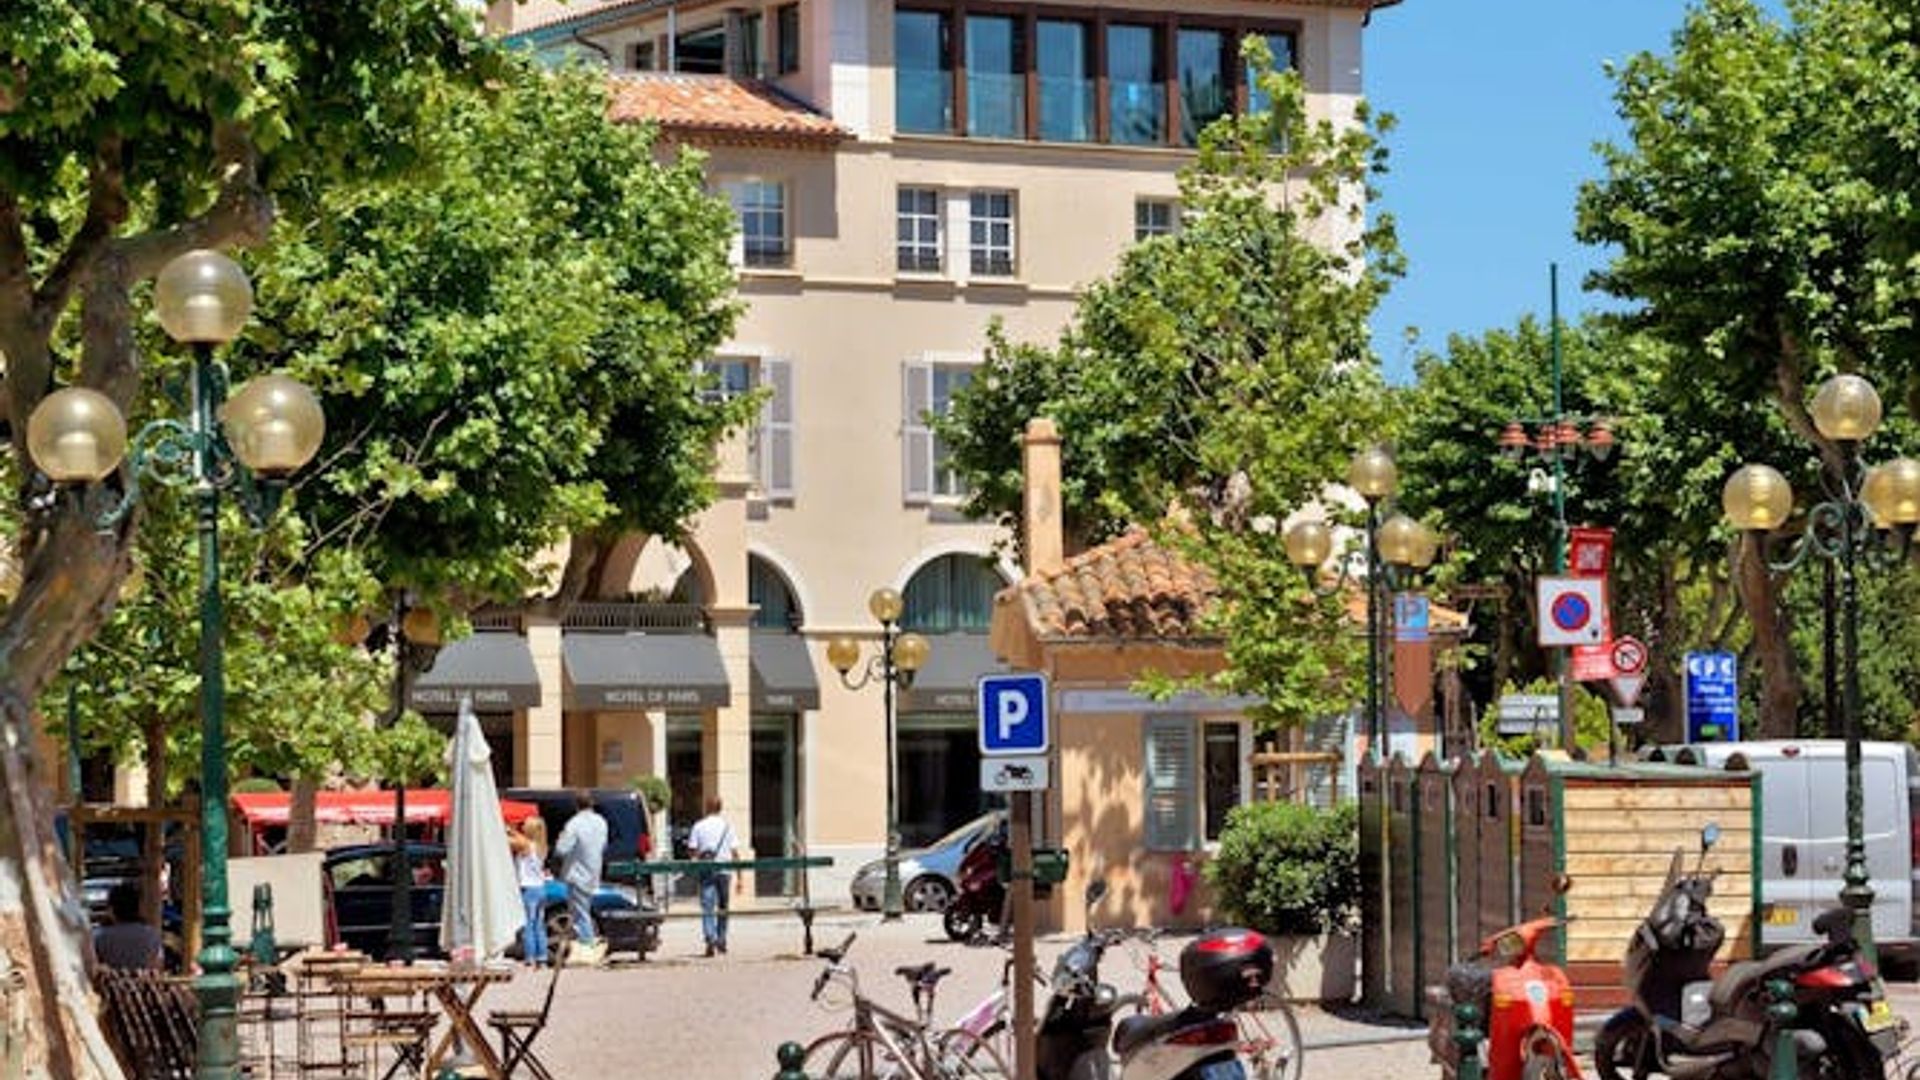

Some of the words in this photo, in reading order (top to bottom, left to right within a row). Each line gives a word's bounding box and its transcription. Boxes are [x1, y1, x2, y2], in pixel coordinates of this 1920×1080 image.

[411, 690, 452, 702] HOTEL
[475, 690, 508, 702] PARIS
[604, 691, 645, 703] HOTEL
[667, 691, 699, 703] PARIS
[998, 689, 1029, 740] P
